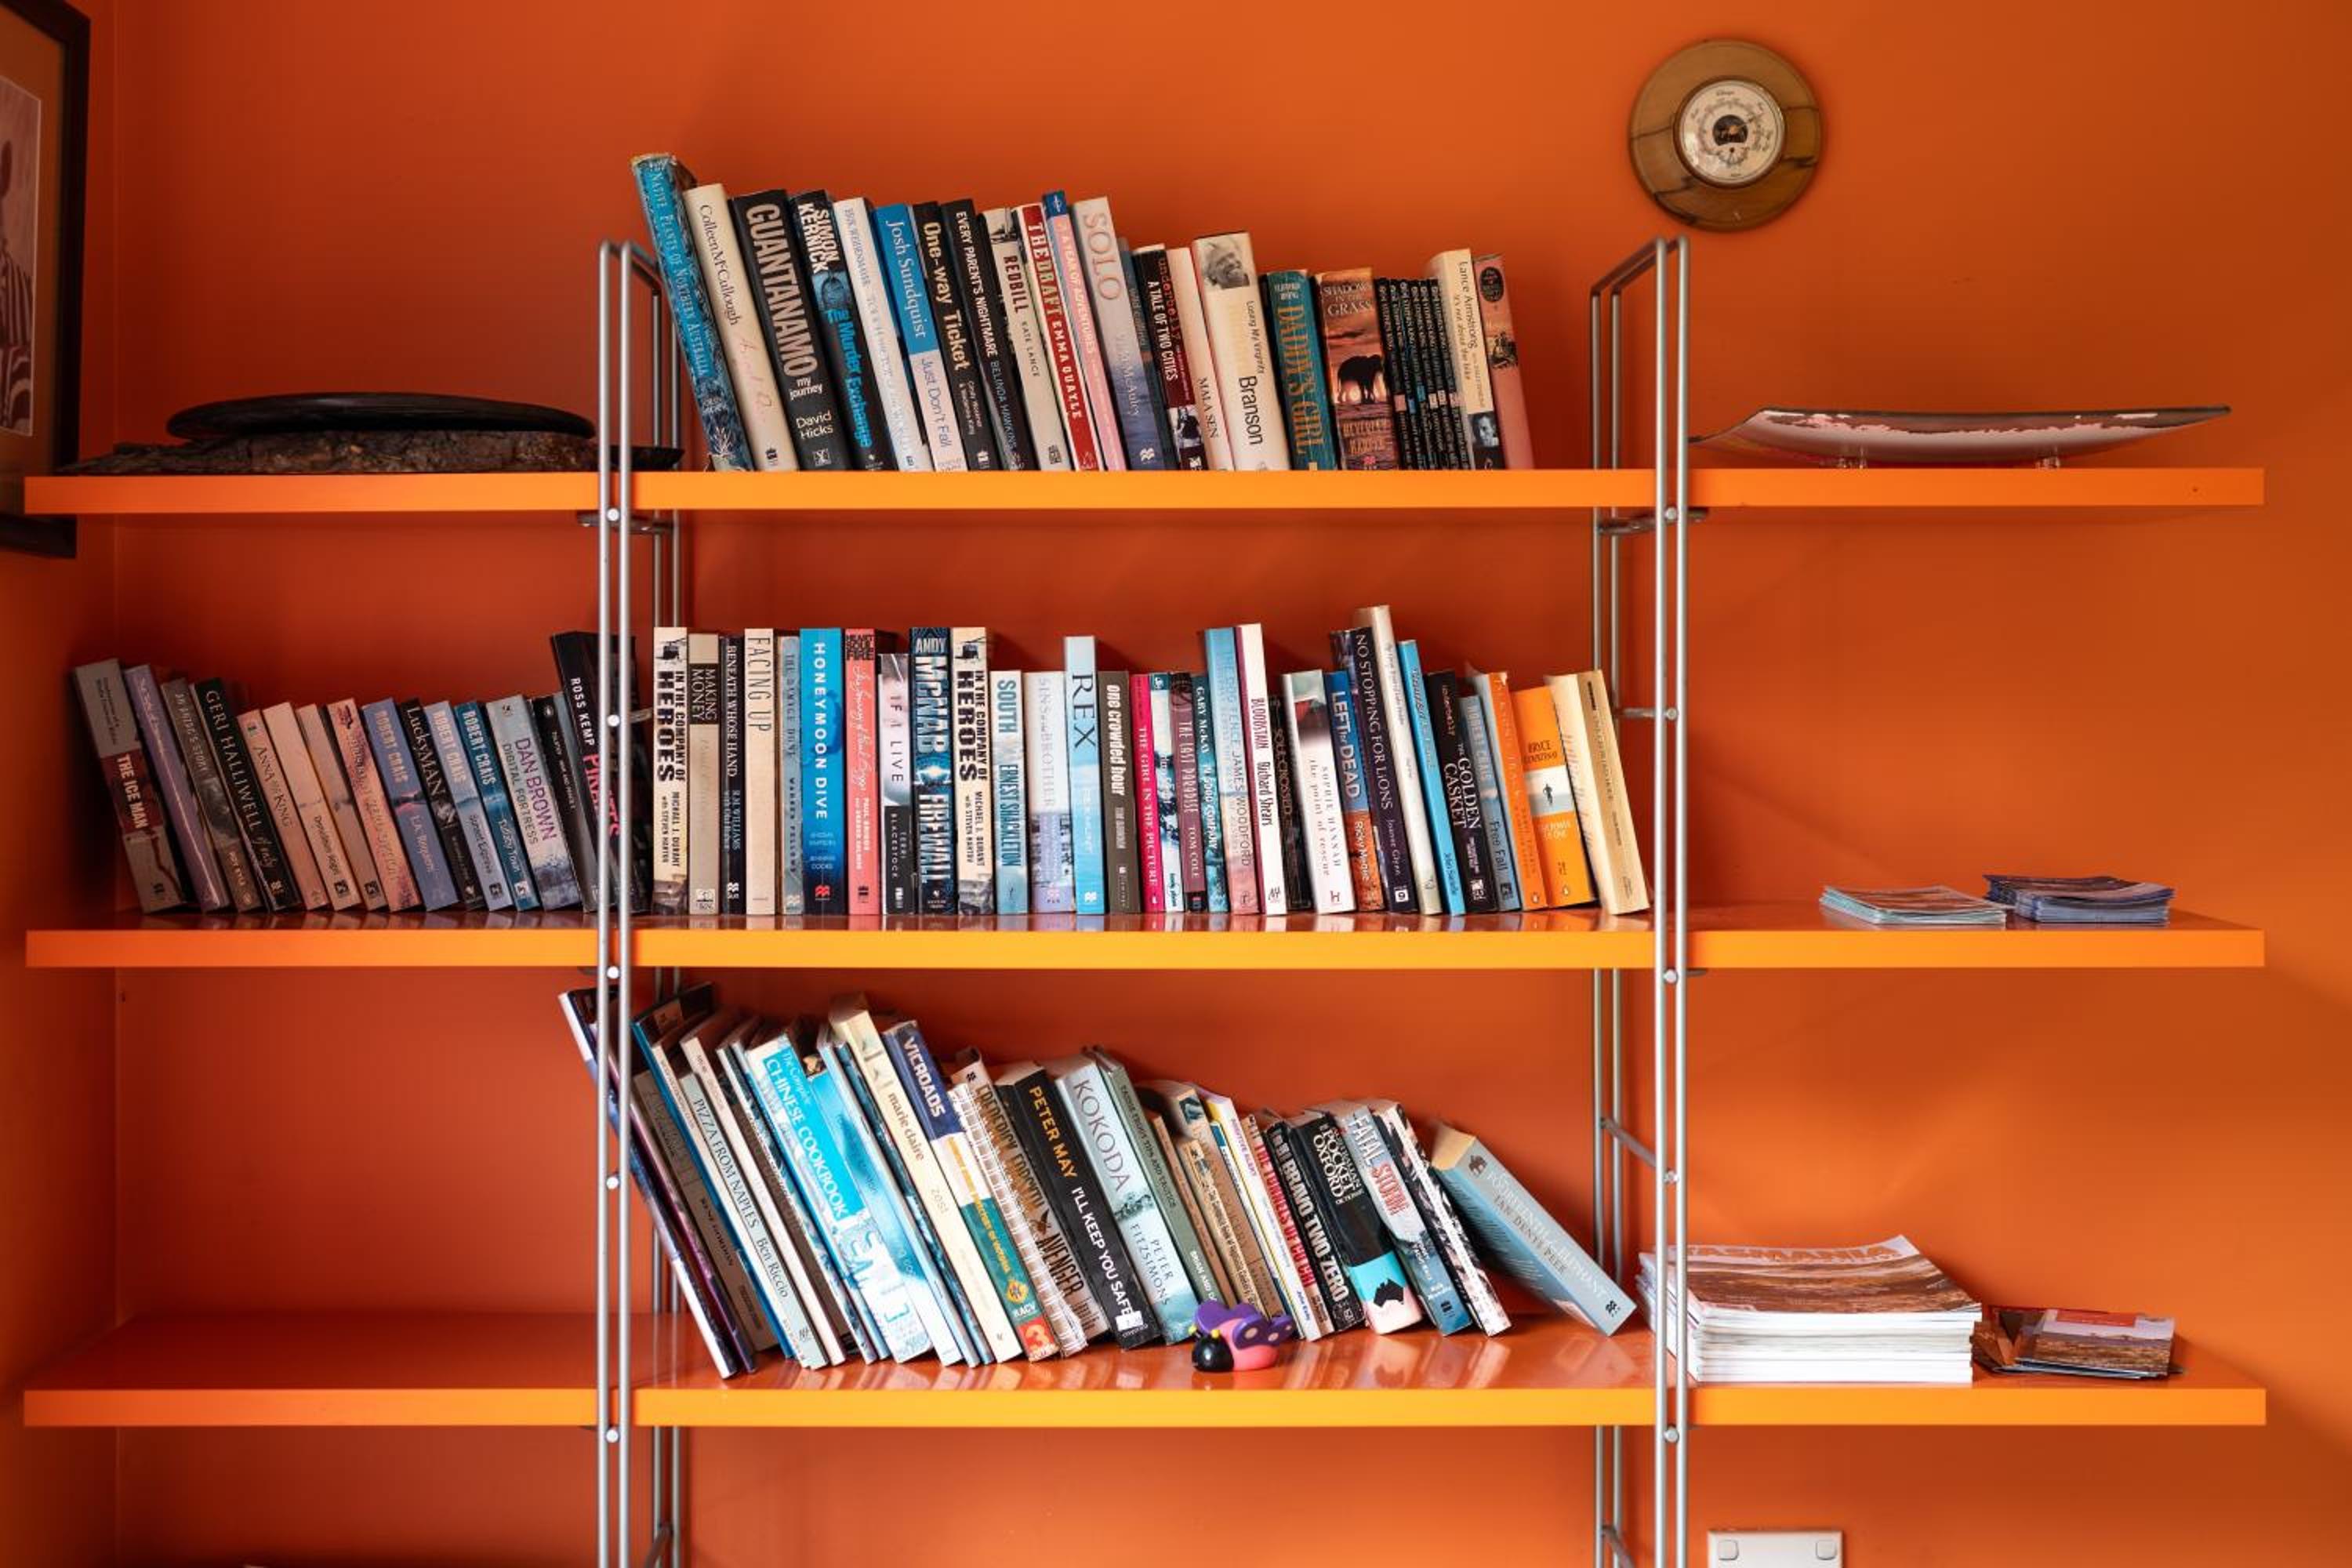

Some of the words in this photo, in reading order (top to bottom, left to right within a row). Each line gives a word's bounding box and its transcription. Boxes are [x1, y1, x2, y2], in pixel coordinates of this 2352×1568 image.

[697, 203, 724, 253] Colleen
[798, 205, 829, 273] KERNICK
[814, 208, 841, 263] SIMON
[887, 220, 911, 257] Josh
[1027, 222, 1049, 260] THE
[1082, 211, 1123, 302] SOLO
[1457, 261, 1471, 292] Lance
[746, 204, 818, 377] GUANTANAMO
[896, 257, 929, 339] Sundquist
[920, 221, 956, 305] One-way
[942, 310, 971, 371] Ticket
[955, 211, 971, 244] EVERY
[963, 245, 983, 295] PARENT'S
[974, 296, 997, 358] NIGHTMARE
[1001, 254, 1029, 314] REDBILL
[1036, 258, 1062, 317] DRAFT
[1149, 289, 1163, 310] TALE
[1020, 320, 1032, 343] KATE
[1154, 312, 1167, 325] OF
[1156, 327, 1171, 349] TWO
[1461, 294, 1480, 349] Armstrong
[837, 321, 862, 375] Murder
[1025, 347, 1040, 378] LANCE
[1160, 350, 1177, 381] CITIES
[797, 377, 812, 387] my
[920, 357, 938, 386] Just
[1051, 320, 1069, 362] EMMA
[1061, 365, 1083, 419] QUAYLE
[789, 383, 822, 401] journey
[844, 376, 873, 448] Exchange
[927, 387, 947, 423] Don't
[989, 361, 1007, 401] BELINDA
[999, 404, 1018, 449] HAWKINS
[1196, 376, 1214, 412] MALA
[1205, 414, 1218, 438] SEN
[1238, 375, 1266, 445] Branson
[796, 412, 832, 428] David
[800, 424, 833, 440] Hicks
[935, 423, 953, 448] Fall
[1287, 399, 1327, 454] GIRL
[916, 637, 947, 653] ANDY
[674, 670, 684, 682] IN
[725, 644, 737, 697] BENEATH
[746, 637, 771, 700] FACING
[973, 670, 984, 682] IN
[569, 677, 586, 709] ROSS
[674, 686, 684, 708] THE
[690, 668, 704, 720] MONEY
[704, 668, 717, 720] MAKING
[812, 641, 828, 768] HONEYMOON
[889, 695, 902, 712] IF
[974, 685, 985, 708] THE
[996, 679, 1018, 733] SOUTH
[1070, 673, 1096, 749] REX
[1105, 684, 1120, 708] one
[1195, 685, 1207, 717] GARY
[1330, 691, 1350, 733] LEFT
[1352, 633, 1368, 659] NO
[1370, 735, 1385, 764] FOR
[577, 713, 596, 747] KEMP
[656, 670, 674, 782] HEROES
[674, 711, 684, 765] COMPANY
[725, 699, 737, 739] WHOSE
[747, 710, 771, 732] UP
[955, 670, 978, 782] HEROES
[975, 710, 987, 764] COMPANY
[1107, 710, 1126, 764] crowded
[1138, 725, 1147, 749] THE
[1177, 720, 1192, 738] THE
[1197, 718, 1209, 753] McKAY
[1250, 698, 1269, 750] BLOODSTAIN
[115, 754, 135, 778] THE
[203, 689, 230, 731] GERI
[218, 735, 265, 830] HALLIWELL
[253, 745, 276, 781] ANNA
[374, 710, 397, 750] ROBERT
[387, 750, 408, 783] CRAIS
[432, 710, 456, 750] ROBERT
[445, 750, 467, 784] CRAIS
[462, 710, 486, 750] ROBERT
[475, 752, 496, 785] CRAIS
[514, 737, 539, 774] DAN
[726, 742, 738, 777] HAND
[889, 740, 904, 782] LIVE
[1178, 741, 1194, 764] LAST
[675, 768, 685, 782] OF
[977, 768, 988, 781] OF
[999, 764, 1019, 801] ERNEST
[1109, 765, 1126, 796] hour
[1139, 753, 1150, 784] GIRL
[1231, 750, 1243, 792] JAMES
[1255, 760, 1272, 797] Richard
[1307, 758, 1318, 779] the
[1338, 744, 1359, 798] DEAD
[122, 779, 142, 802] ICE
[272, 793, 294, 827] KING
[500, 742, 522, 785] DIGITAL
[513, 787, 540, 845] FORTRESS
[524, 775, 559, 840] BROWN
[815, 777, 828, 819] DIVE
[1142, 787, 1151, 800] IN
[1180, 768, 1198, 814] PARADISE
[1258, 797, 1275, 826] Shears
[1308, 783, 1323, 815] point
[1443, 761, 1467, 829] CASKET
[1457, 757, 1482, 830] GOLDEN
[128, 801, 150, 829] MAN
[1000, 803, 1021, 866] SHACKLETON
[1143, 804, 1153, 829] THE
[1235, 795, 1251, 867] WOODFORD
[1316, 819, 1325, 833] of
[1319, 765, 1333, 810] SOPHIE
[1327, 816, 1341, 867] HANNAH
[1487, 820, 1504, 847] Free
[788, 825, 797, 873] FELLOWS
[898, 831, 907, 858] TERRI
[917, 793, 951, 884] FIREWALL
[1187, 826, 1197, 849] TOM
[1317, 837, 1330, 877] rescue
[1145, 832, 1157, 886] PICTURE
[1189, 851, 1200, 879] COLE
[1493, 848, 1509, 872] Fall
[781, 1051, 795, 1067] The
[900, 1036, 946, 1118] VICROADS
[764, 1057, 804, 1126] CHINESE
[797, 1124, 849, 1218] COOKBOOK
[887, 1091, 911, 1128] marie
[902, 1127, 926, 1163] claire
[974, 1083, 1017, 1153] FREDERICK
[1007, 1153, 1044, 1210] FORSYTH
[1027, 1085, 1062, 1142] PETER
[1051, 1142, 1077, 1181] MAY
[1072, 1079, 1132, 1192] KOKODA
[692, 1098, 718, 1138] PIZZA
[711, 1139, 737, 1180] FROM
[729, 1178, 760, 1229] NAPLES
[1253, 1143, 1271, 1167] THE
[1311, 1133, 1345, 1199] OXFORD
[1321, 1129, 1354, 1193] POCKET
[1348, 1114, 1385, 1166] FATAL
[1371, 1162, 1409, 1215] STORM
[1070, 1186, 1091, 1213] I'LL
[1262, 1170, 1293, 1225] TUNNELS
[1080, 1212, 1105, 1250] KEEP
[1280, 1159, 1314, 1216] BRAVO
[1303, 1217, 1331, 1258] TWO
[1319, 1258, 1349, 1301] ZERO
[1283, 1225, 1298, 1241] OF
[756, 1236, 774, 1260] Ben
[766, 1261, 791, 1299] Riccio
[1036, 1232, 1083, 1298] AVENGER
[1097, 1251, 1118, 1280] YOU
[1130, 1222, 1171, 1306] FITZSIMONS
[1149, 1238, 1174, 1280] PETER
[1290, 1243, 1306, 1262] CU
[1297, 1262, 1316, 1287] CHI
[1109, 1280, 1134, 1316] SAFE
[1025, 1324, 1047, 1351] 3
